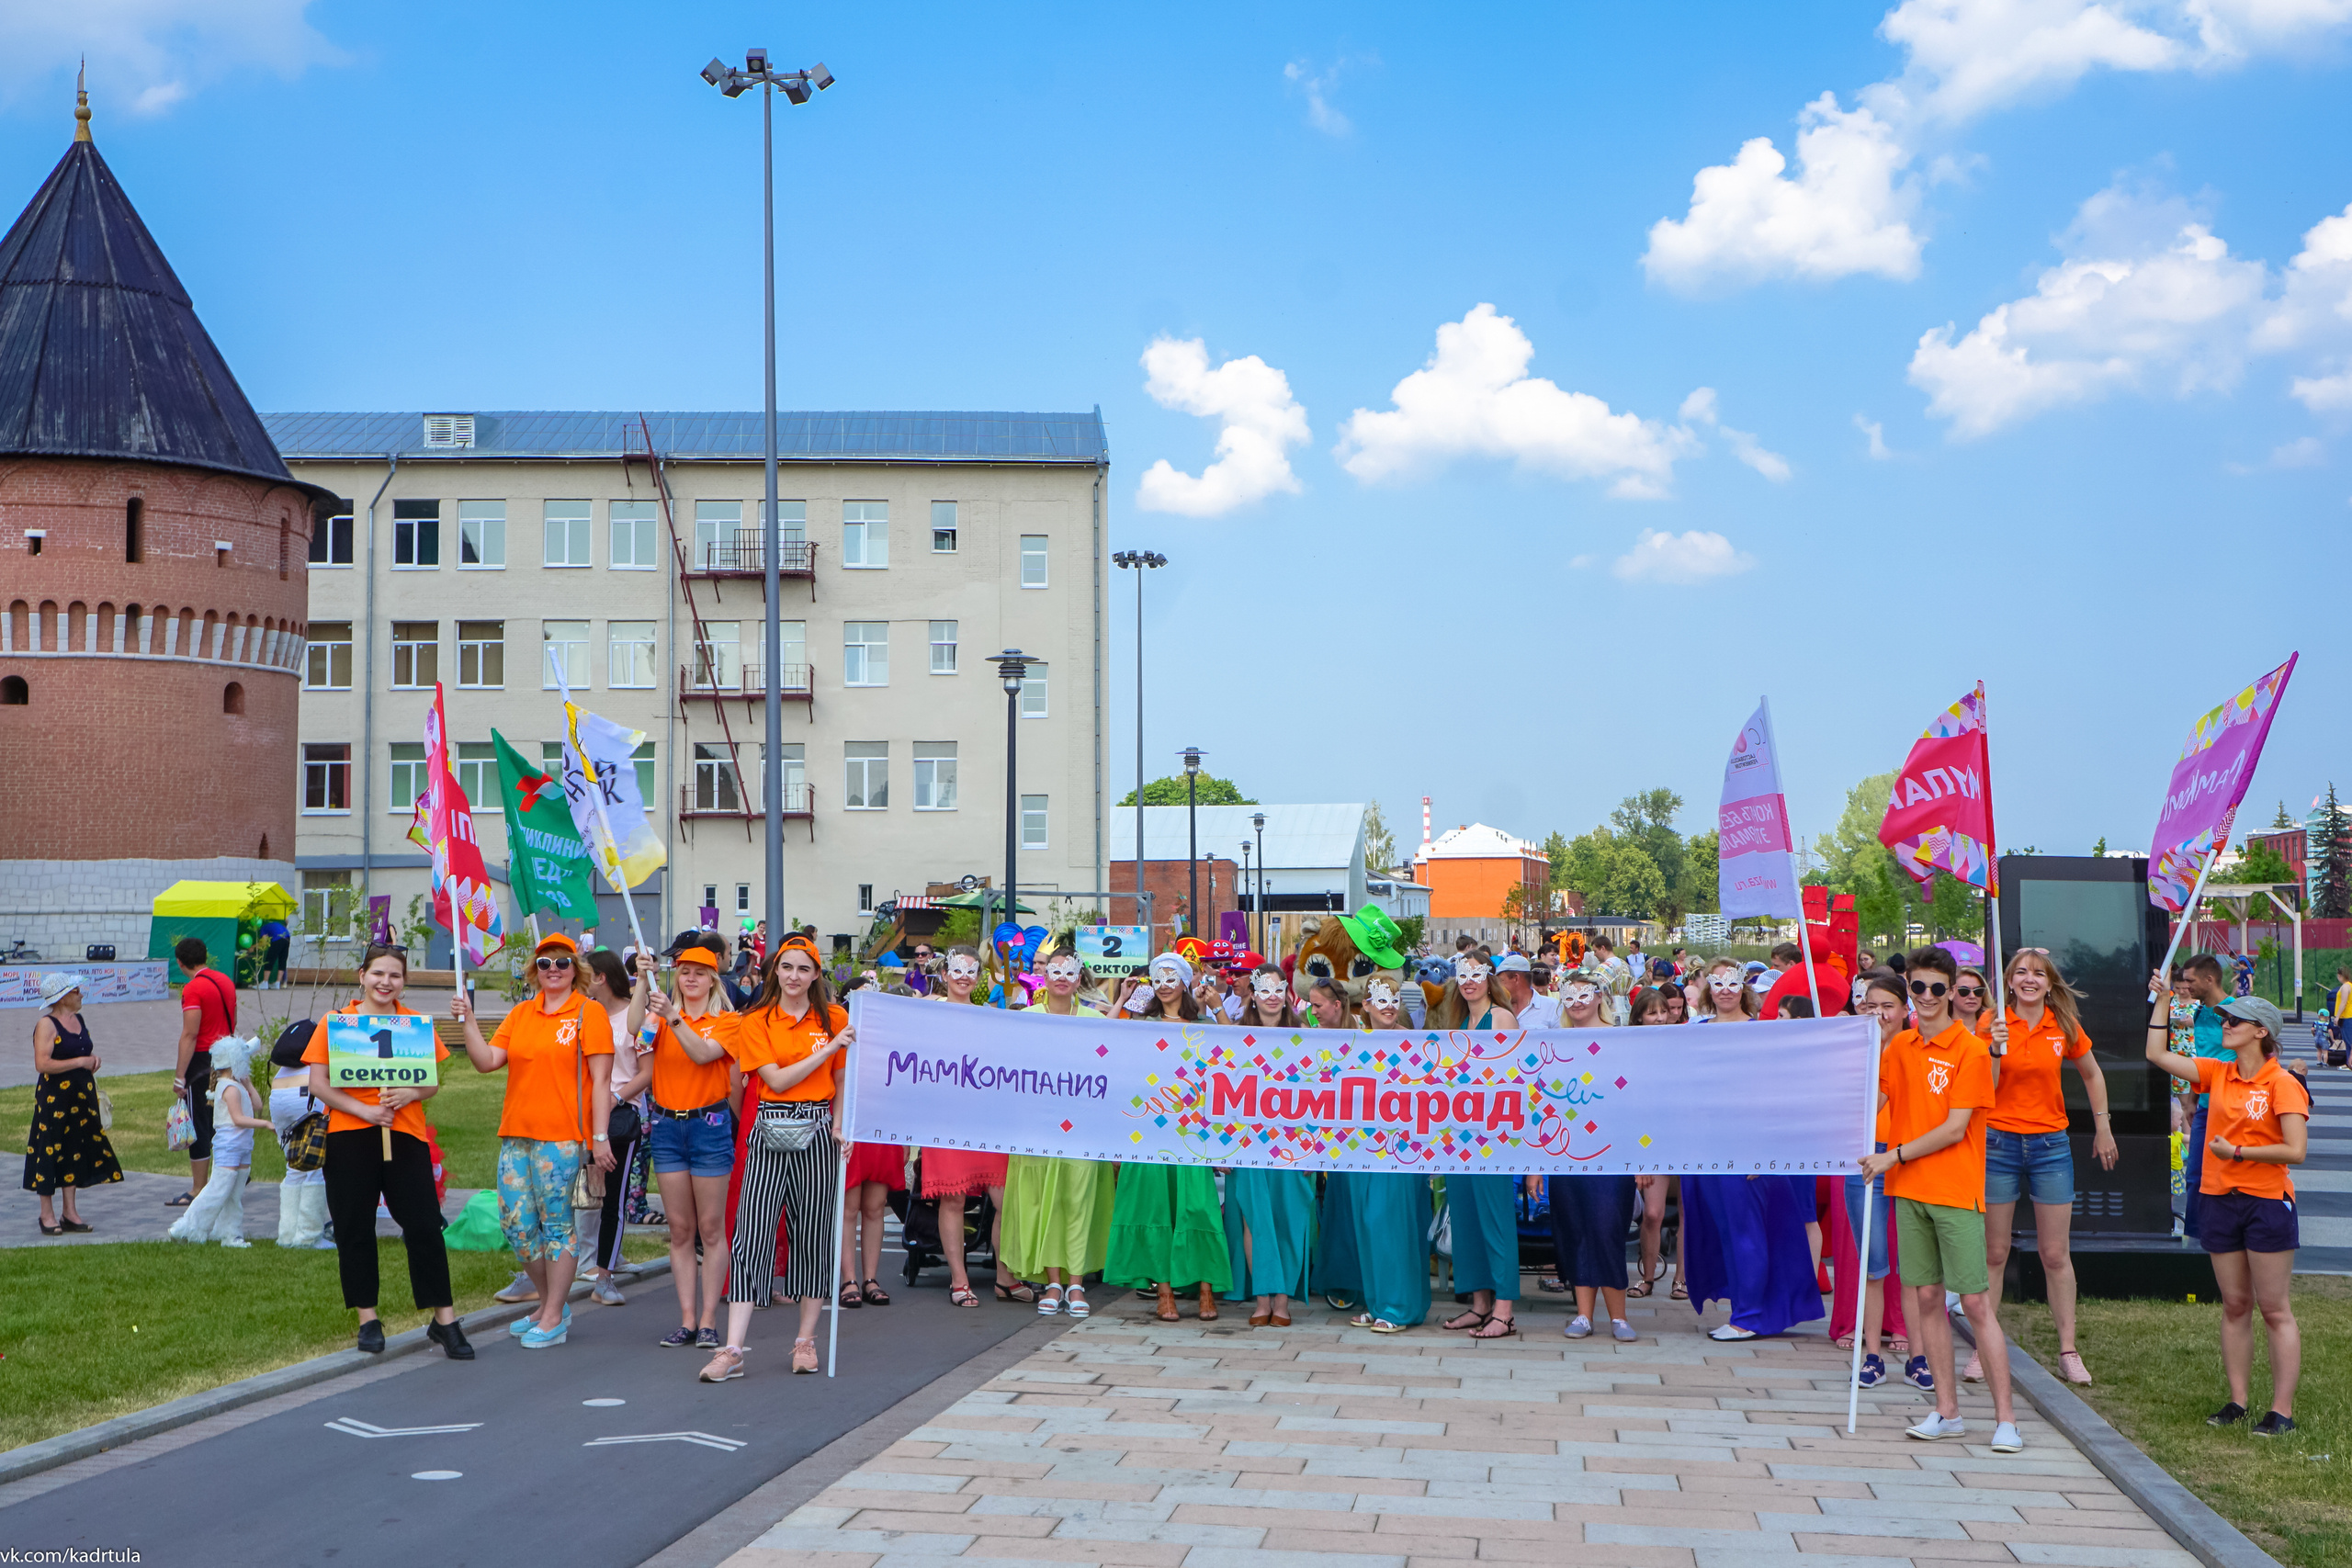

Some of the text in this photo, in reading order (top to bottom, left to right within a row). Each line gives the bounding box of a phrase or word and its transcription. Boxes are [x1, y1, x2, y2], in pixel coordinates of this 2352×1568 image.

[1102, 935, 1123, 958] 2
[23, 979, 41, 987] ЛЕТО
[23, 987, 41, 996] МОРЕ
[369, 1029, 394, 1059] 1
[340, 1068, 428, 1084] сектор
[1211, 1071, 1526, 1135] МамПарад
[874, 1129, 912, 1142] При
[933, 1136, 1063, 1157] поддержке
[1083, 1152, 1274, 1167] администрации
[1418, 1164, 1603, 1173] правительства
[1624, 1160, 1735, 1172] Тульской
[1754, 1160, 1846, 1170] области
